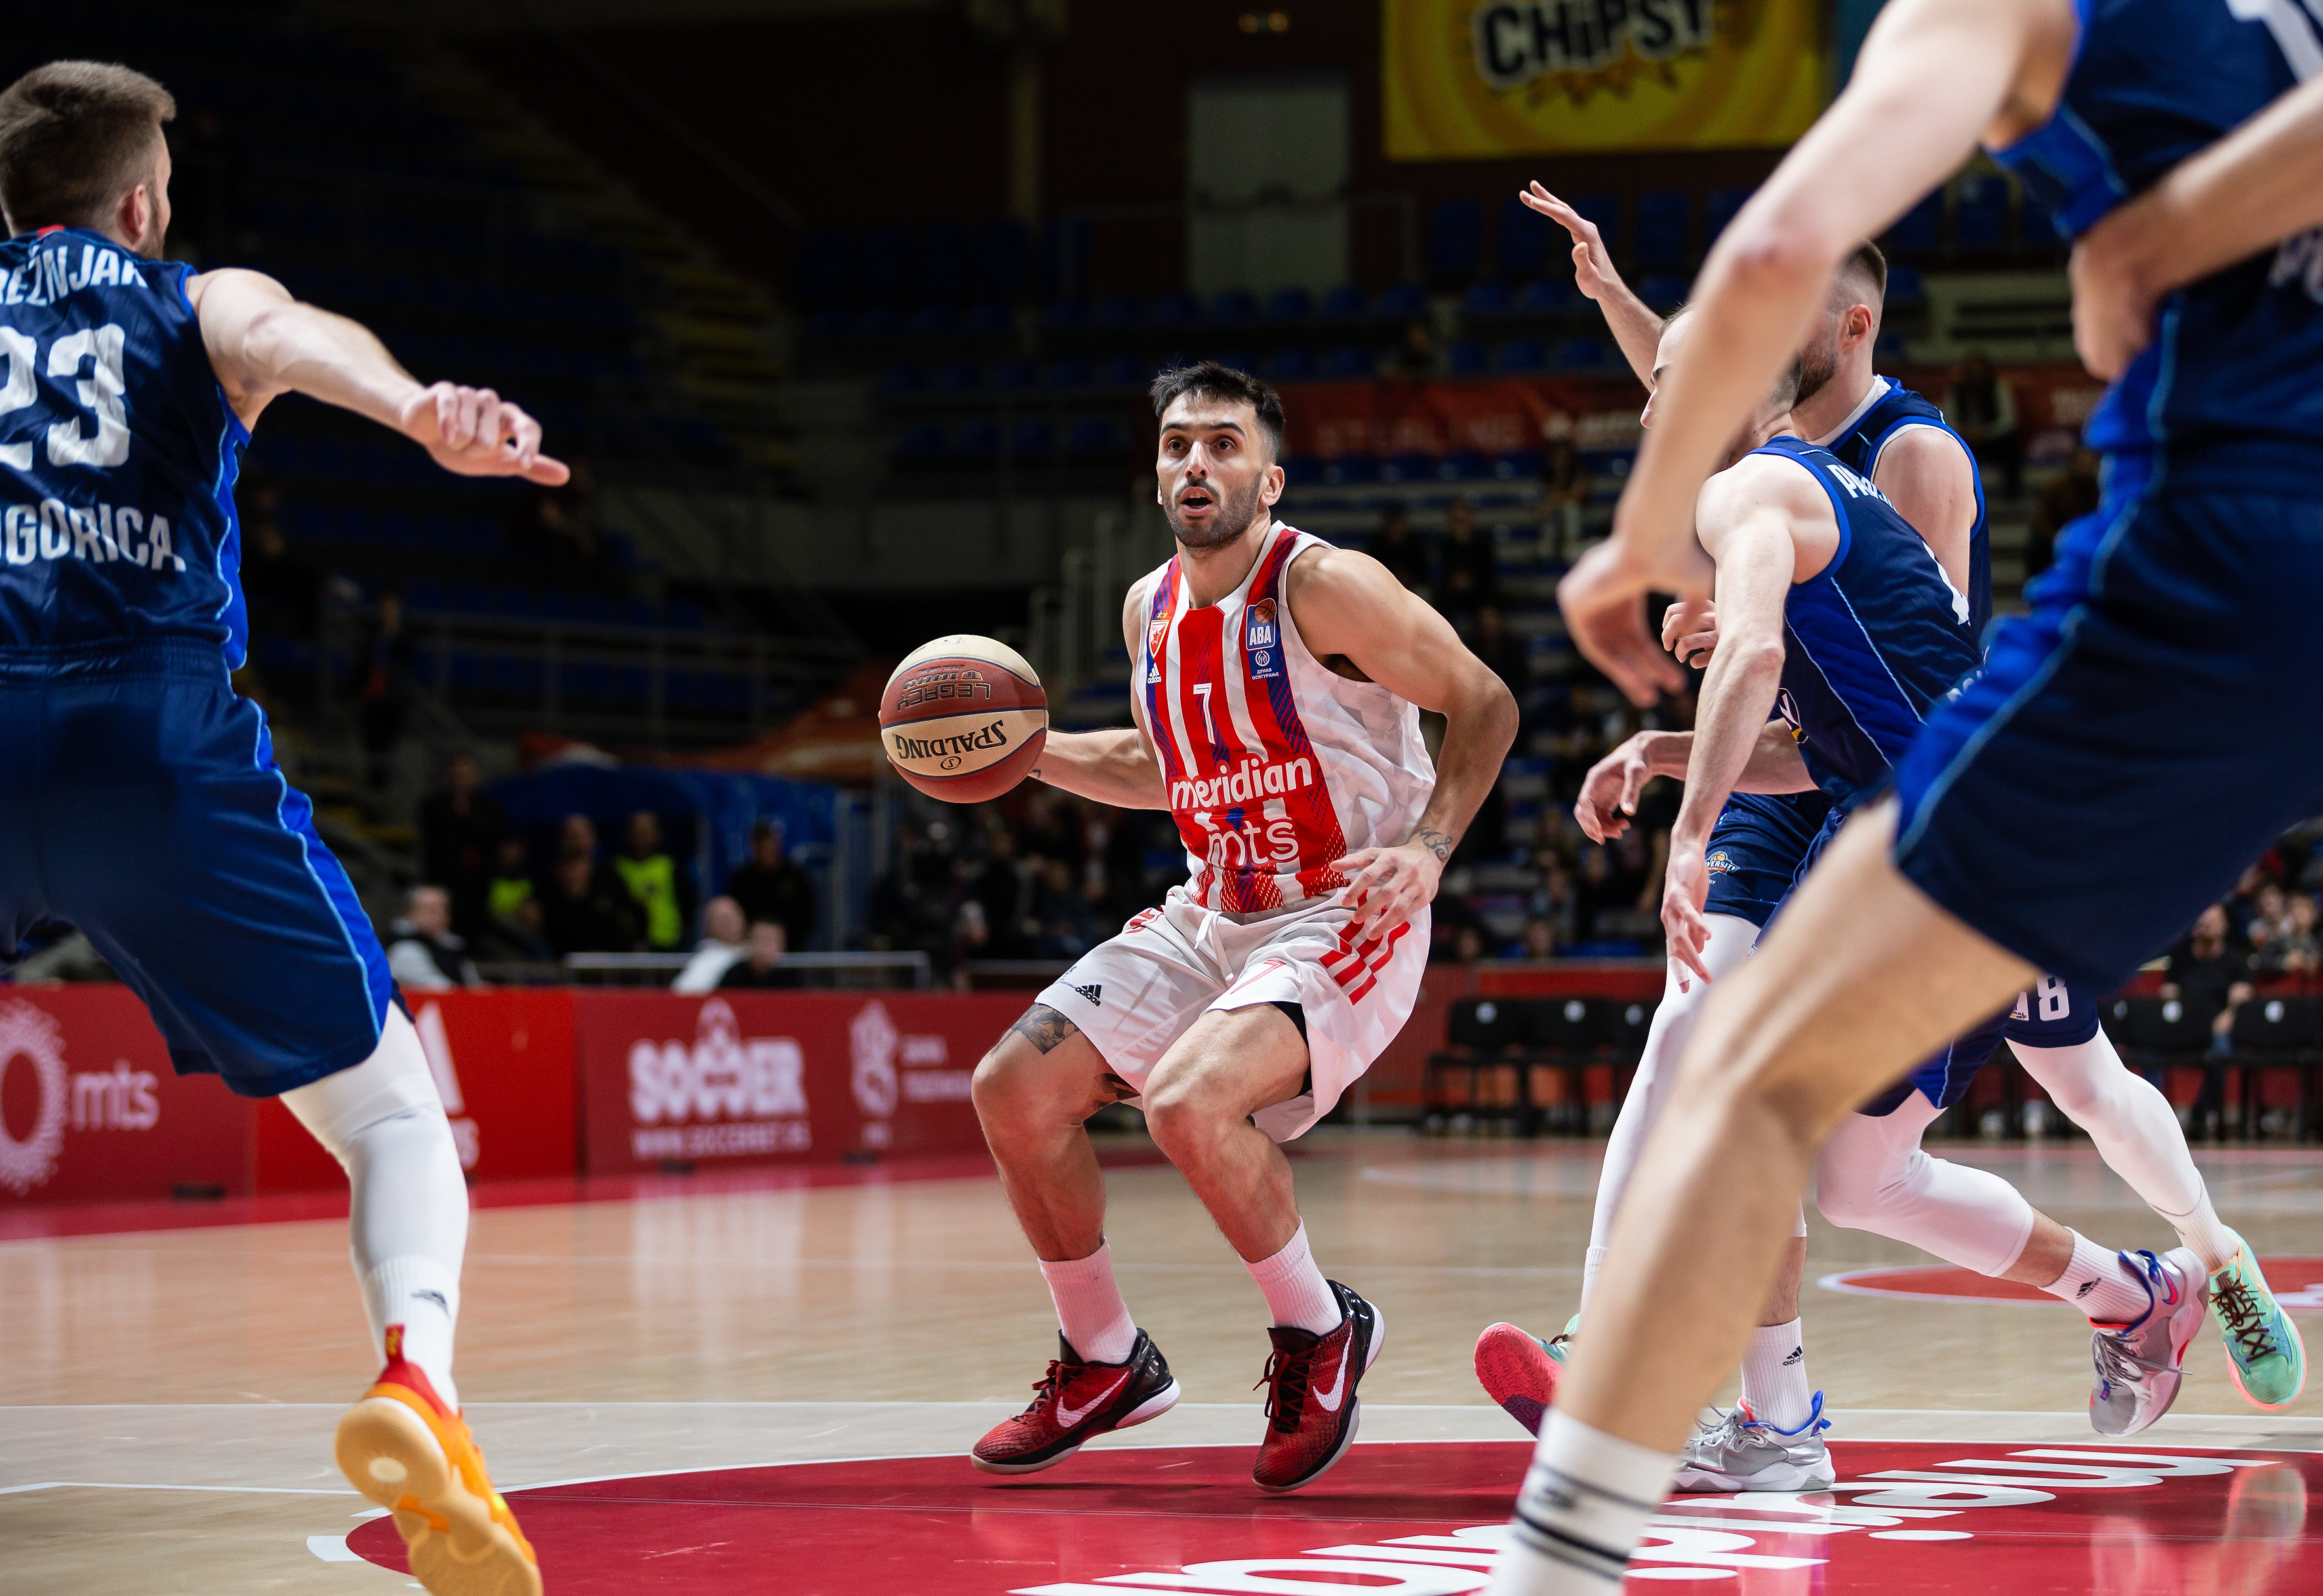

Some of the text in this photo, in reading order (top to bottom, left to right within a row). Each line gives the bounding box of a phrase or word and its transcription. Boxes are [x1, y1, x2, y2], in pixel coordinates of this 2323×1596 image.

[0, 498, 187, 572] GORICA
[1250, 626, 1272, 646] ABA
[897, 683, 991, 711] LEGACY
[903, 672, 958, 689] 1000
[1147, 675, 1162, 684] adidas
[1193, 683, 1215, 745] 7
[896, 719, 1007, 759] SPALDING
[1172, 757, 1313, 811] meridian
[1208, 820, 1300, 866] mts
[1705, 860, 1736, 871] VERSITY
[1230, 959, 1286, 995] 7
[1075, 986, 1102, 1007] adidas
[71, 1061, 159, 1130] mts
[1782, 1355, 1803, 1366] adid
[1008, 1449, 2282, 1596] meridia
